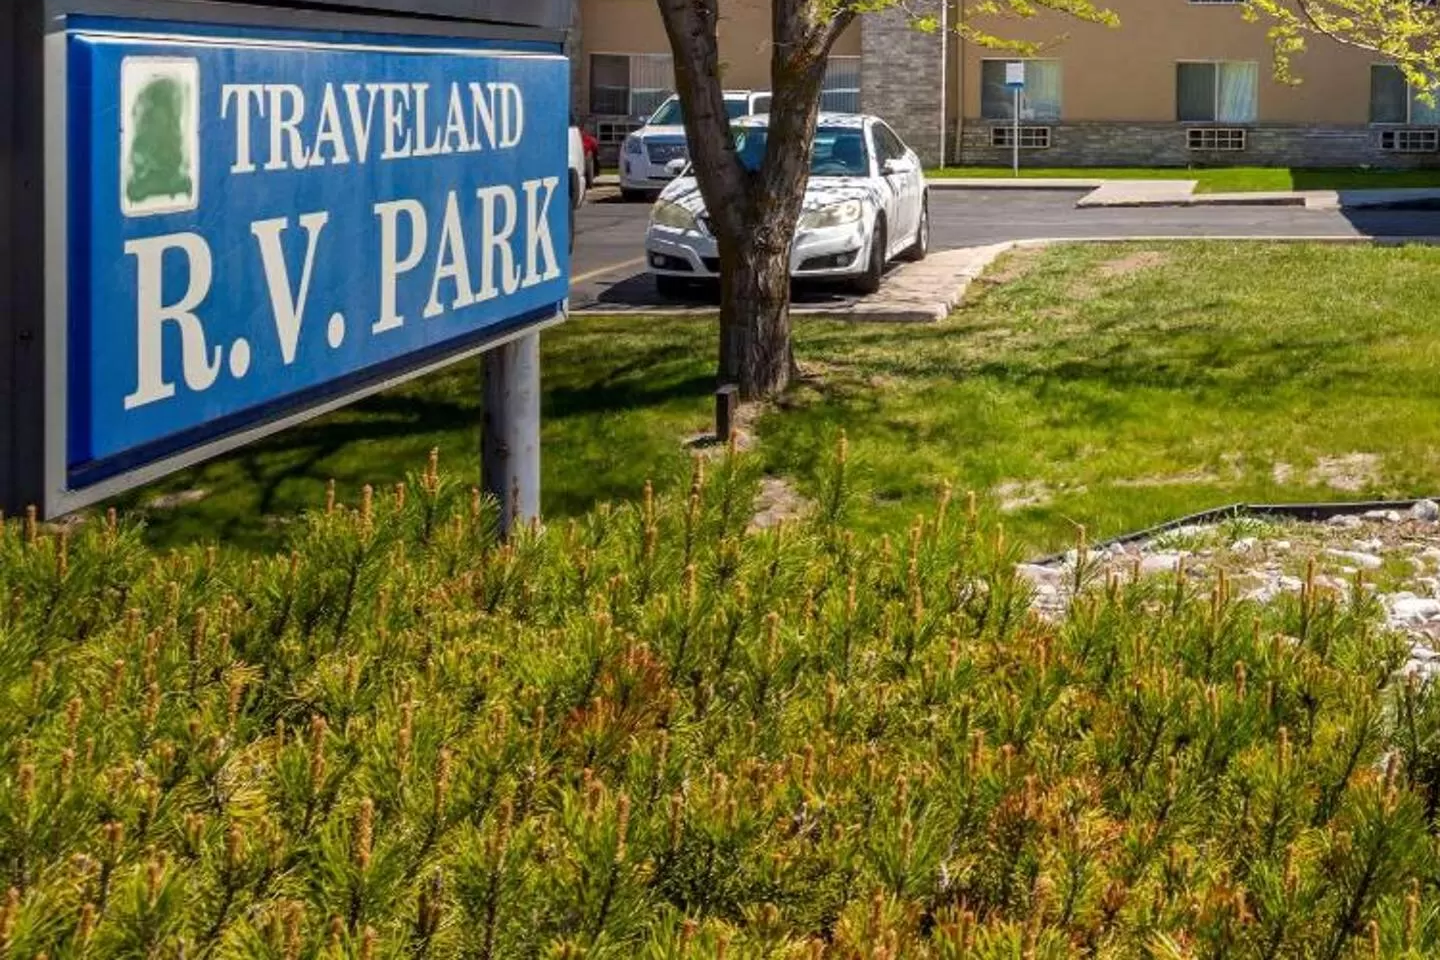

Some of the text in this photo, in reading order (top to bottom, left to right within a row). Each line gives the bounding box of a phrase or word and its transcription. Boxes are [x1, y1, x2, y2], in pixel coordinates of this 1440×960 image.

[221, 82, 524, 174] TRAVELAND
[124, 176, 561, 410] R.V. PARK
